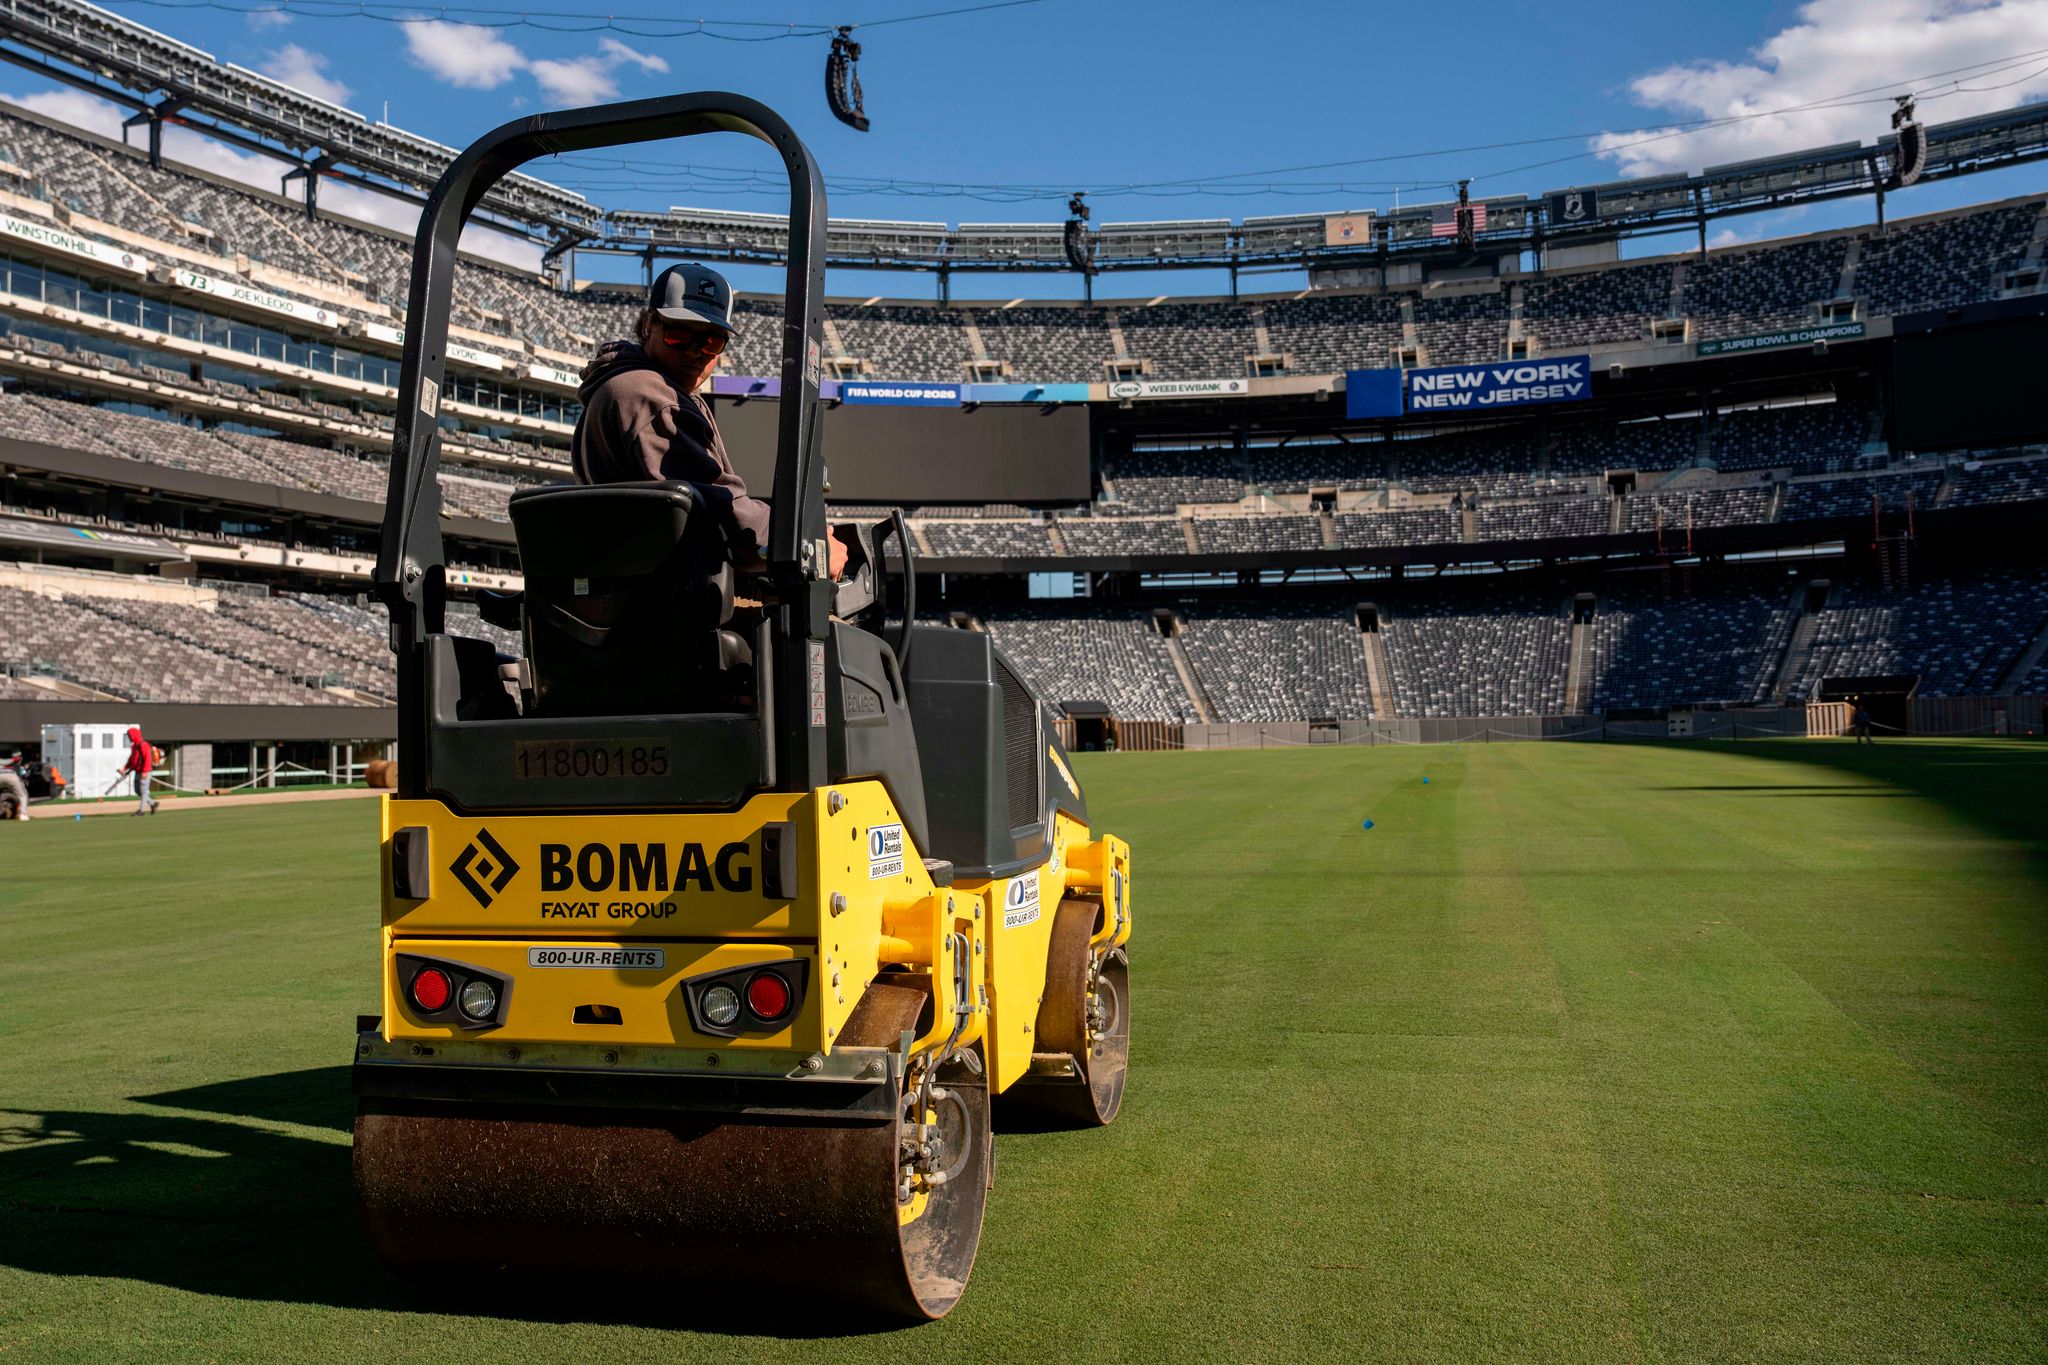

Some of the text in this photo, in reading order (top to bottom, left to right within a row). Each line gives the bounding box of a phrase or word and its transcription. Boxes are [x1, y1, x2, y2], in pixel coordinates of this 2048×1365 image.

[5, 219, 97, 256] WINSTON HILL
[188, 274, 207, 289] 73
[232, 288, 294, 312] JOE KLECKO
[1722, 337, 1755, 350] SUPER
[1756, 334, 1789, 346] BOWL
[1799, 325, 1862, 340] CHAMPIONS
[554, 371, 567, 382] 74
[1413, 362, 1583, 391] NEW YORK
[848, 387, 956, 399] FIFA WORLD CUP 2026
[1149, 383, 1221, 393] WEEB EWBANK
[1414, 382, 1584, 408] NEW JERSEY
[518, 747, 668, 777] 11800185
[884, 829, 900, 841] United
[885, 841, 901, 854] Rentals
[540, 842, 753, 893] BOMAG
[872, 862, 901, 876] 800-UR-RENTS
[541, 902, 678, 919] FAYAT GROUP
[537, 951, 656, 966] 800-UR-RENTS
